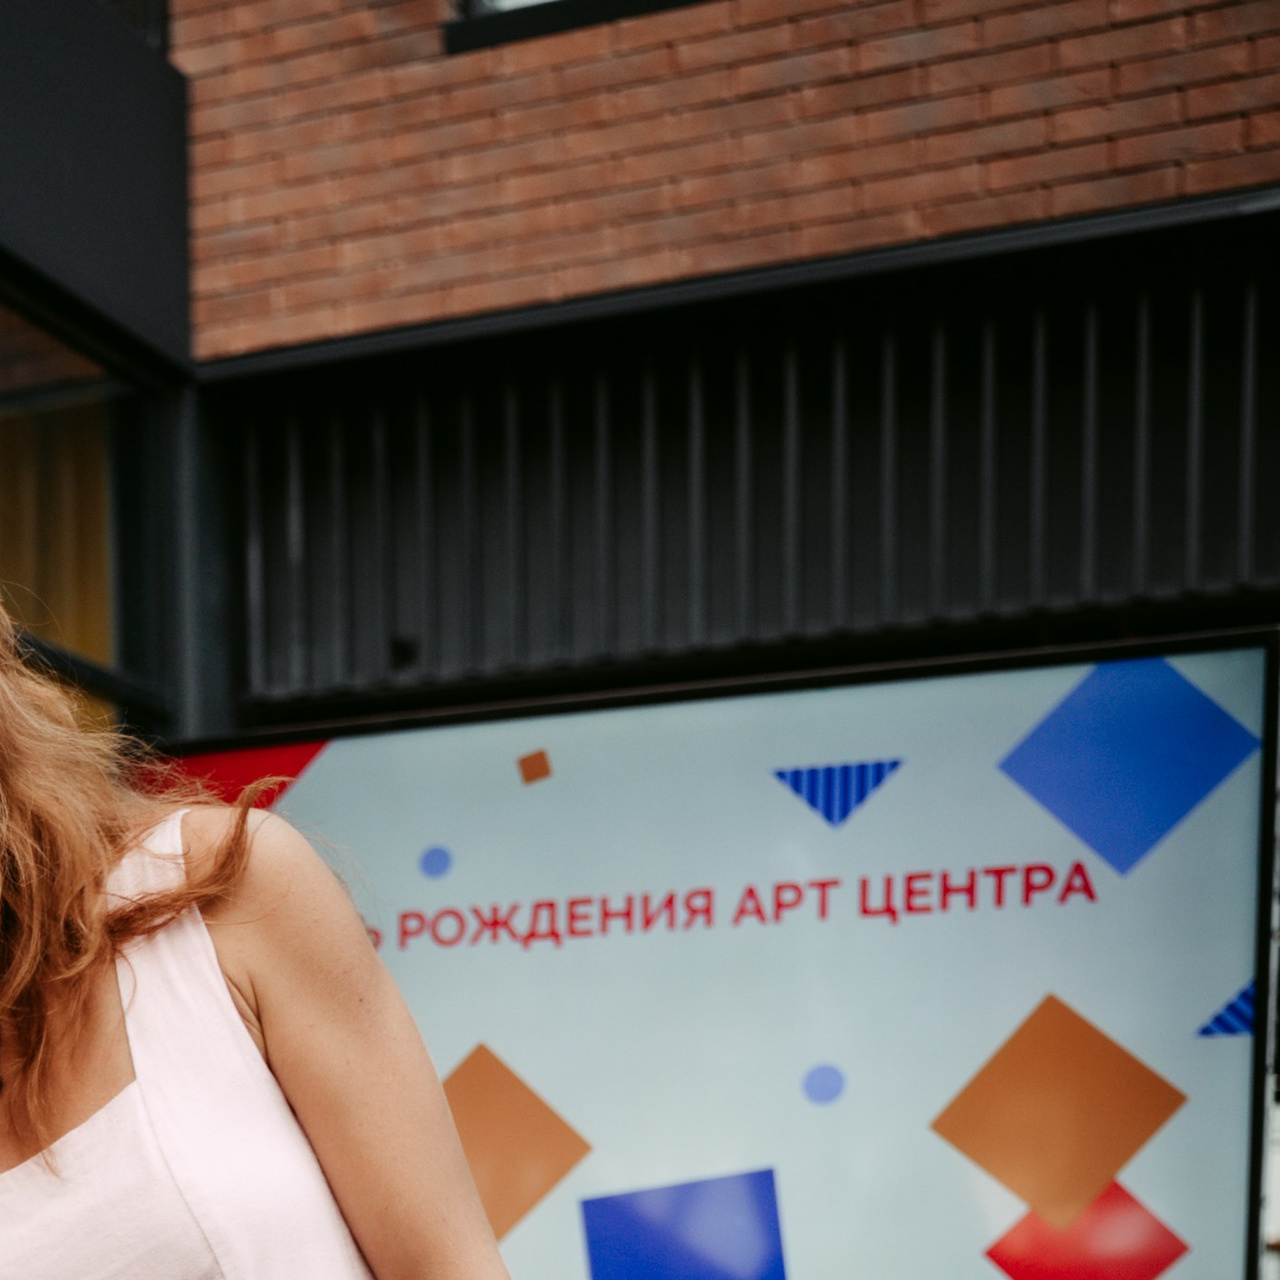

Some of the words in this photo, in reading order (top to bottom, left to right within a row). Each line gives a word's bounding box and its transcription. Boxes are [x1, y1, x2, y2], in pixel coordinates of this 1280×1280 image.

[397, 886, 715, 950] РОЖДЕНИЯ
[732, 877, 841, 926] АРТ
[858, 860, 1098, 926] ЦЕНТРА
